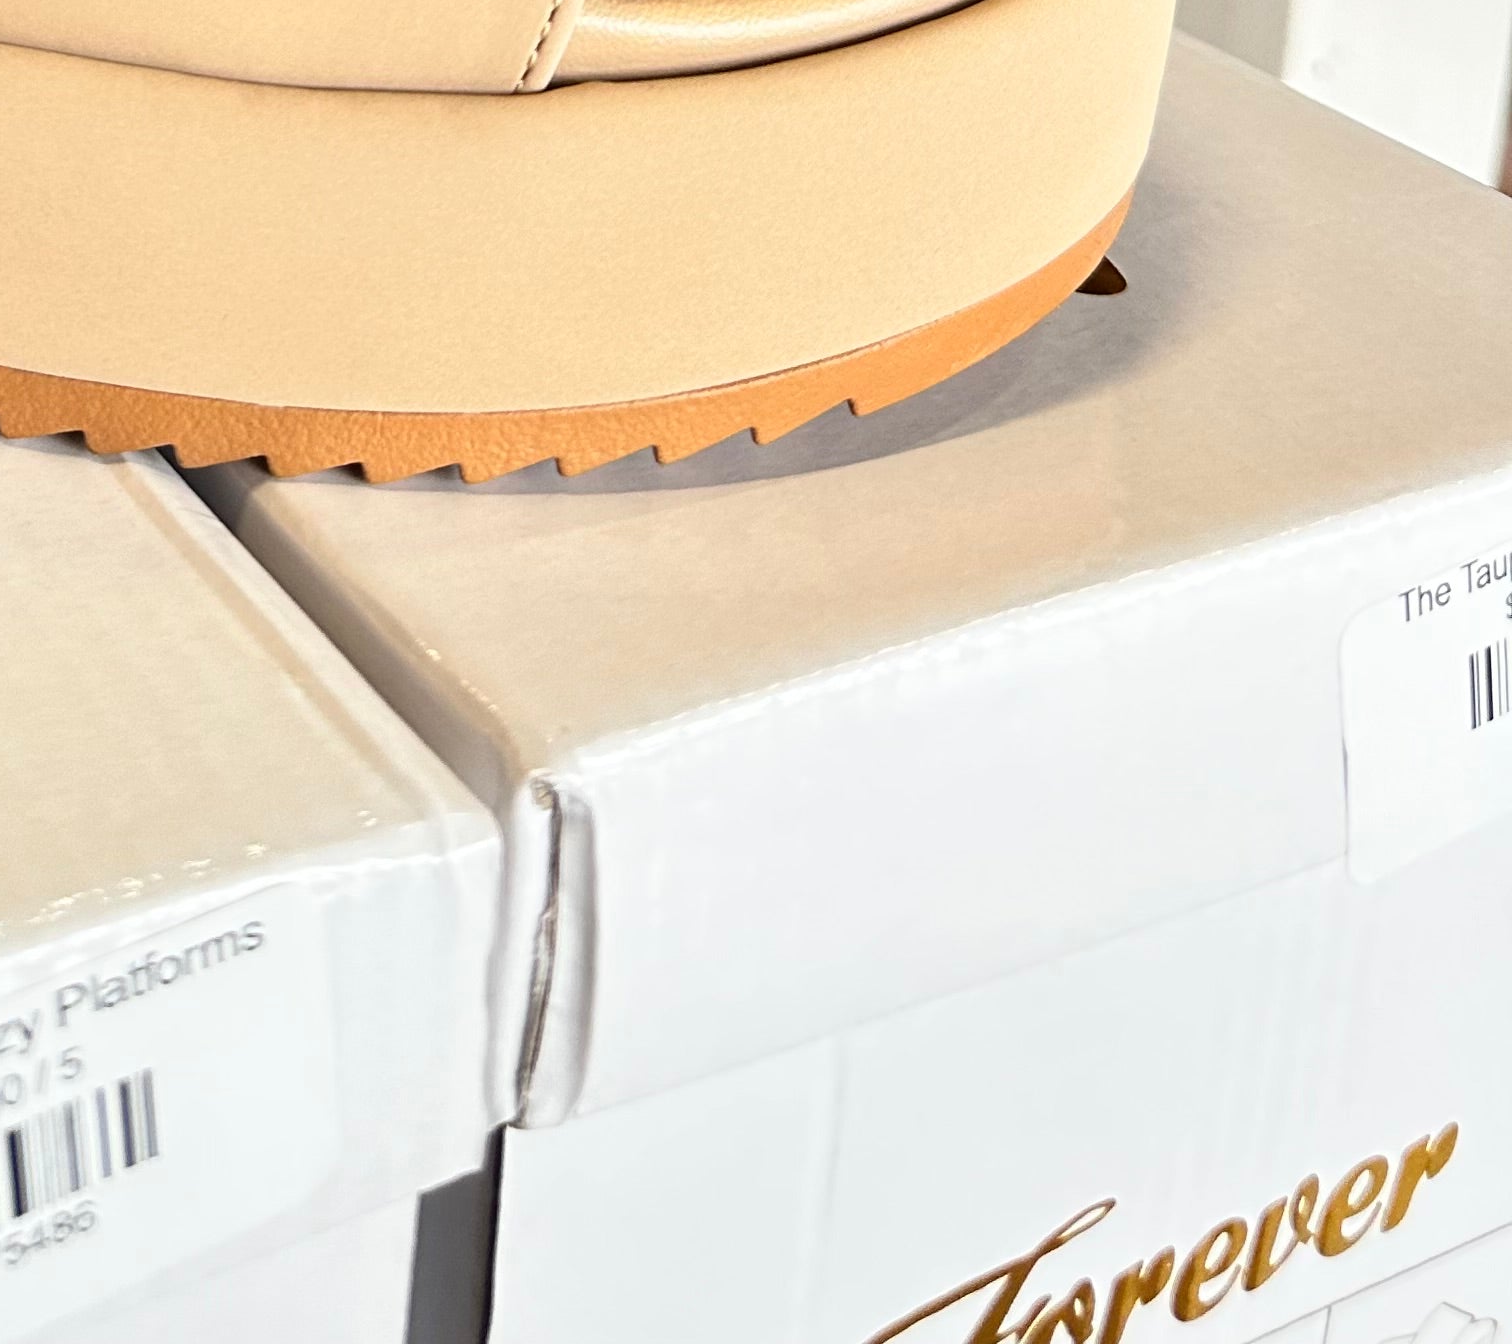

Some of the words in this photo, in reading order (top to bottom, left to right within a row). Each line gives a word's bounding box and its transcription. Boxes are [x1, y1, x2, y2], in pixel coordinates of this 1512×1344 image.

[1399, 581, 1451, 622] The
[1460, 552, 1512, 593] Tau
[55, 919, 265, 1026] Platforms
[59, 1045, 84, 1081] 5
